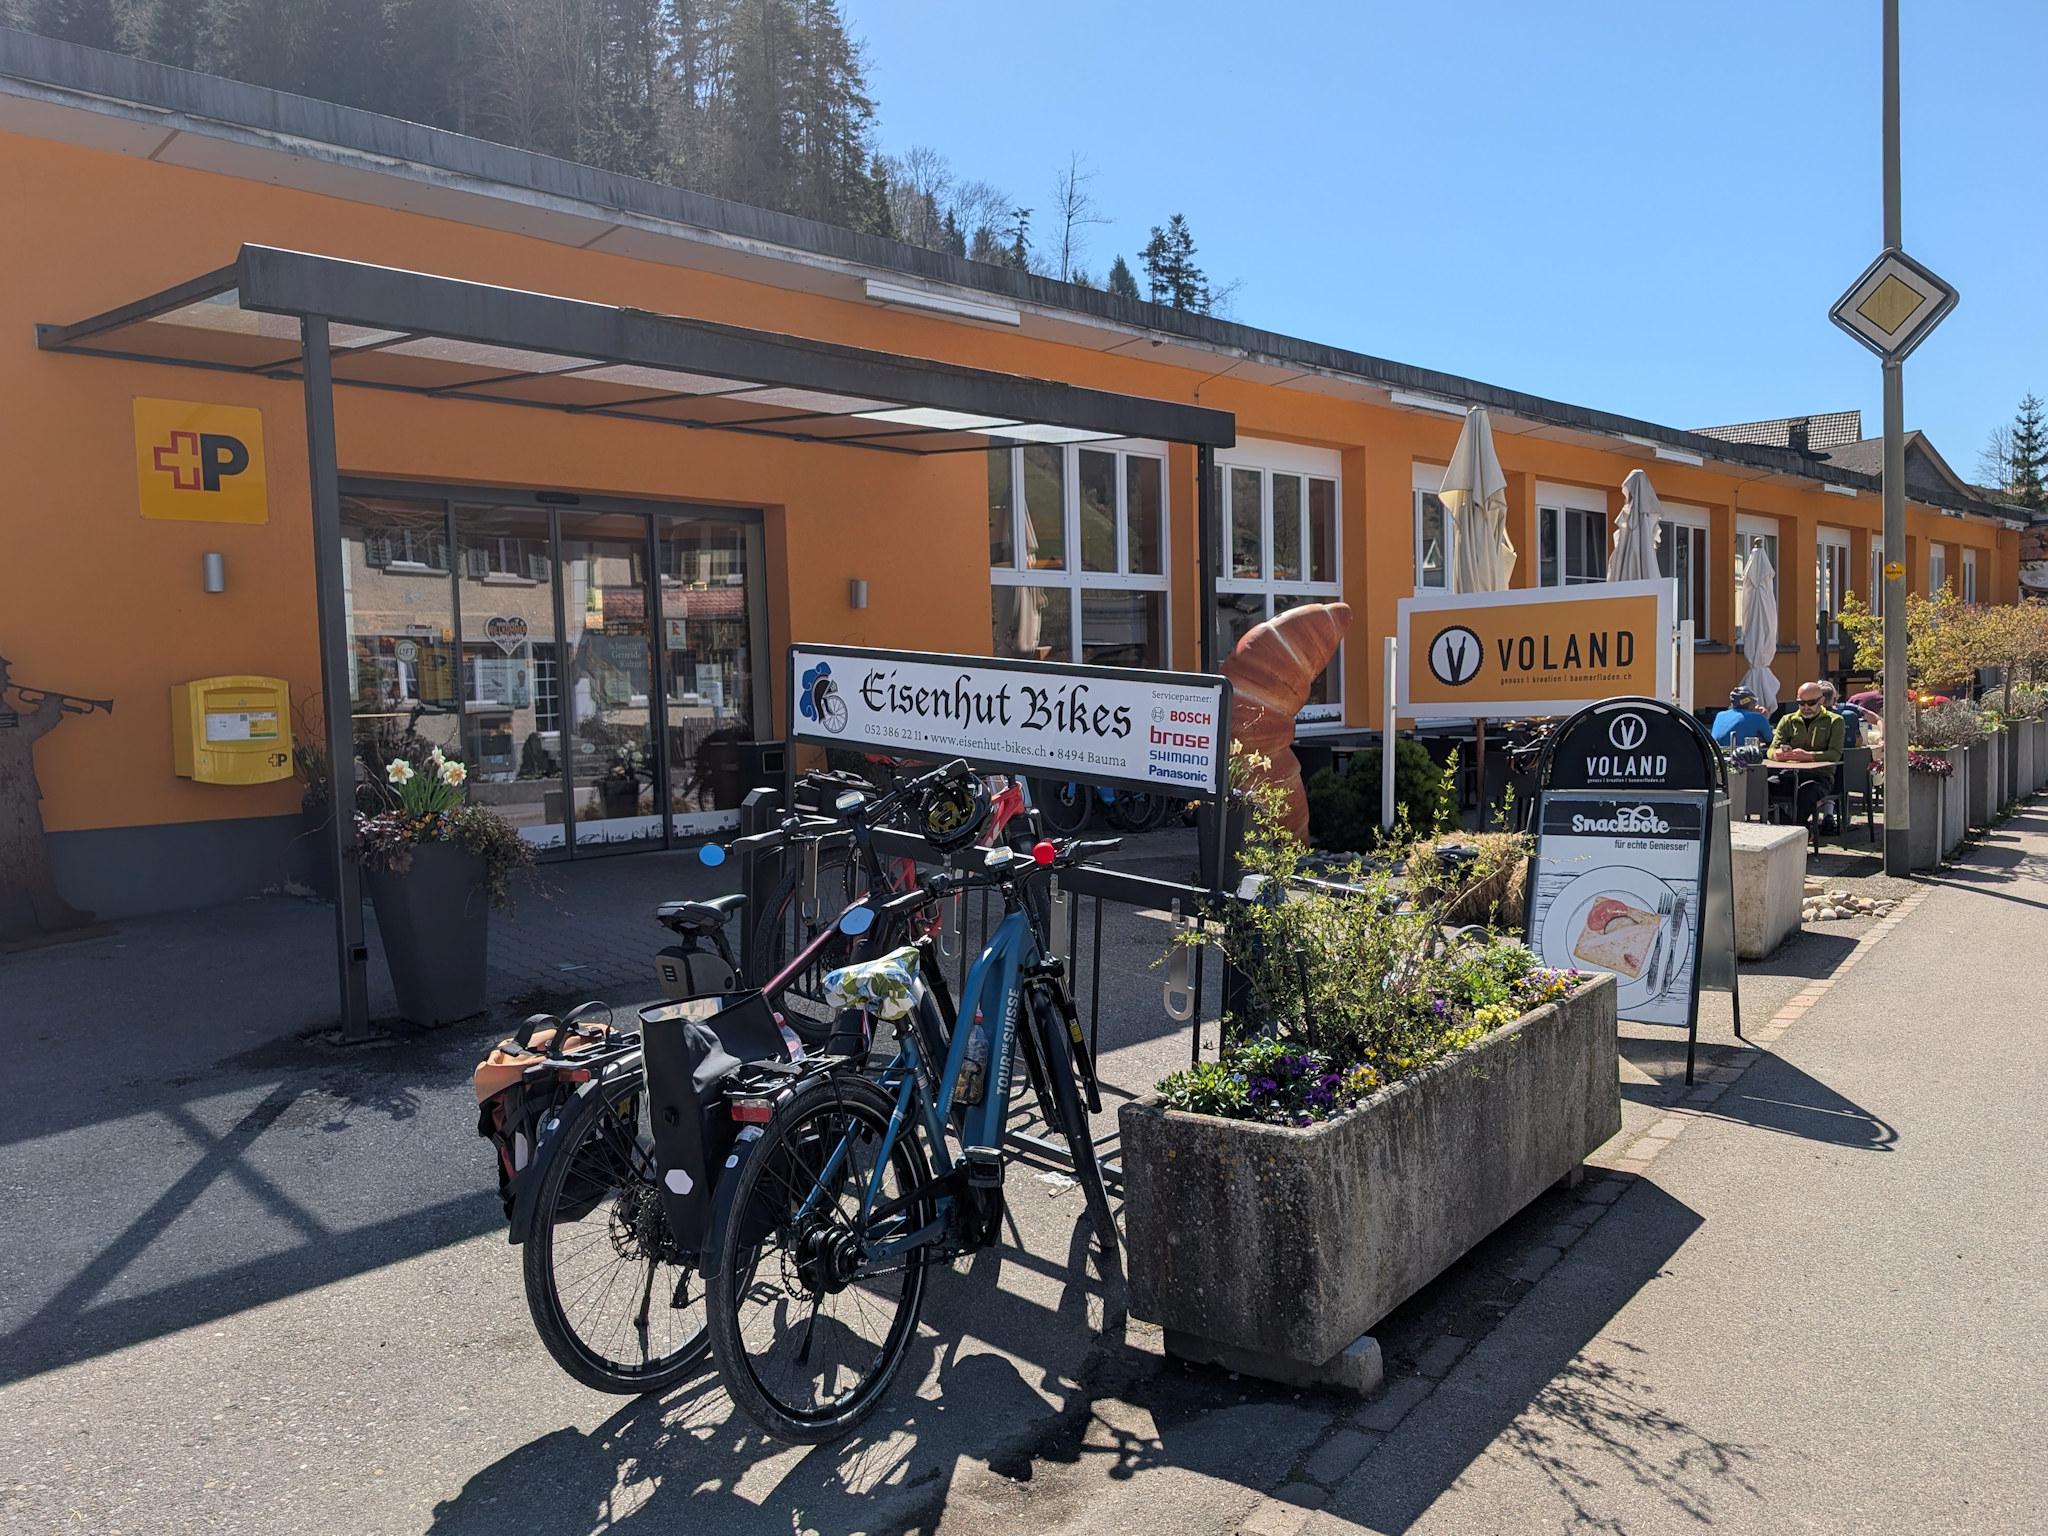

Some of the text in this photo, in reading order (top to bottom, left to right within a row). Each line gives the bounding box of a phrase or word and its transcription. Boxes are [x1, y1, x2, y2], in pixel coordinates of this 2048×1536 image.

[200, 433, 249, 491] P
[1497, 631, 1634, 672] VOLAND
[1532, 675, 1561, 684] kreation
[859, 667, 1132, 739] Eisenhut Bikes
[1152, 690, 1212, 703] Servicepartner:
[1170, 710, 1211, 725] BOSCH
[864, 723, 1127, 767] 052 386 22 11 www.eisenhut-bikes.ch 8494 Bauma
[1150, 725, 1210, 749] brose
[1149, 750, 1209, 766] SHIMANO
[1586, 755, 1667, 777] VOLAND
[1149, 764, 1208, 782] Panasonic
[1614, 839, 1690, 852] für echte Geniesser!
[997, 988, 1020, 1095] TOUR DE SUISSE
